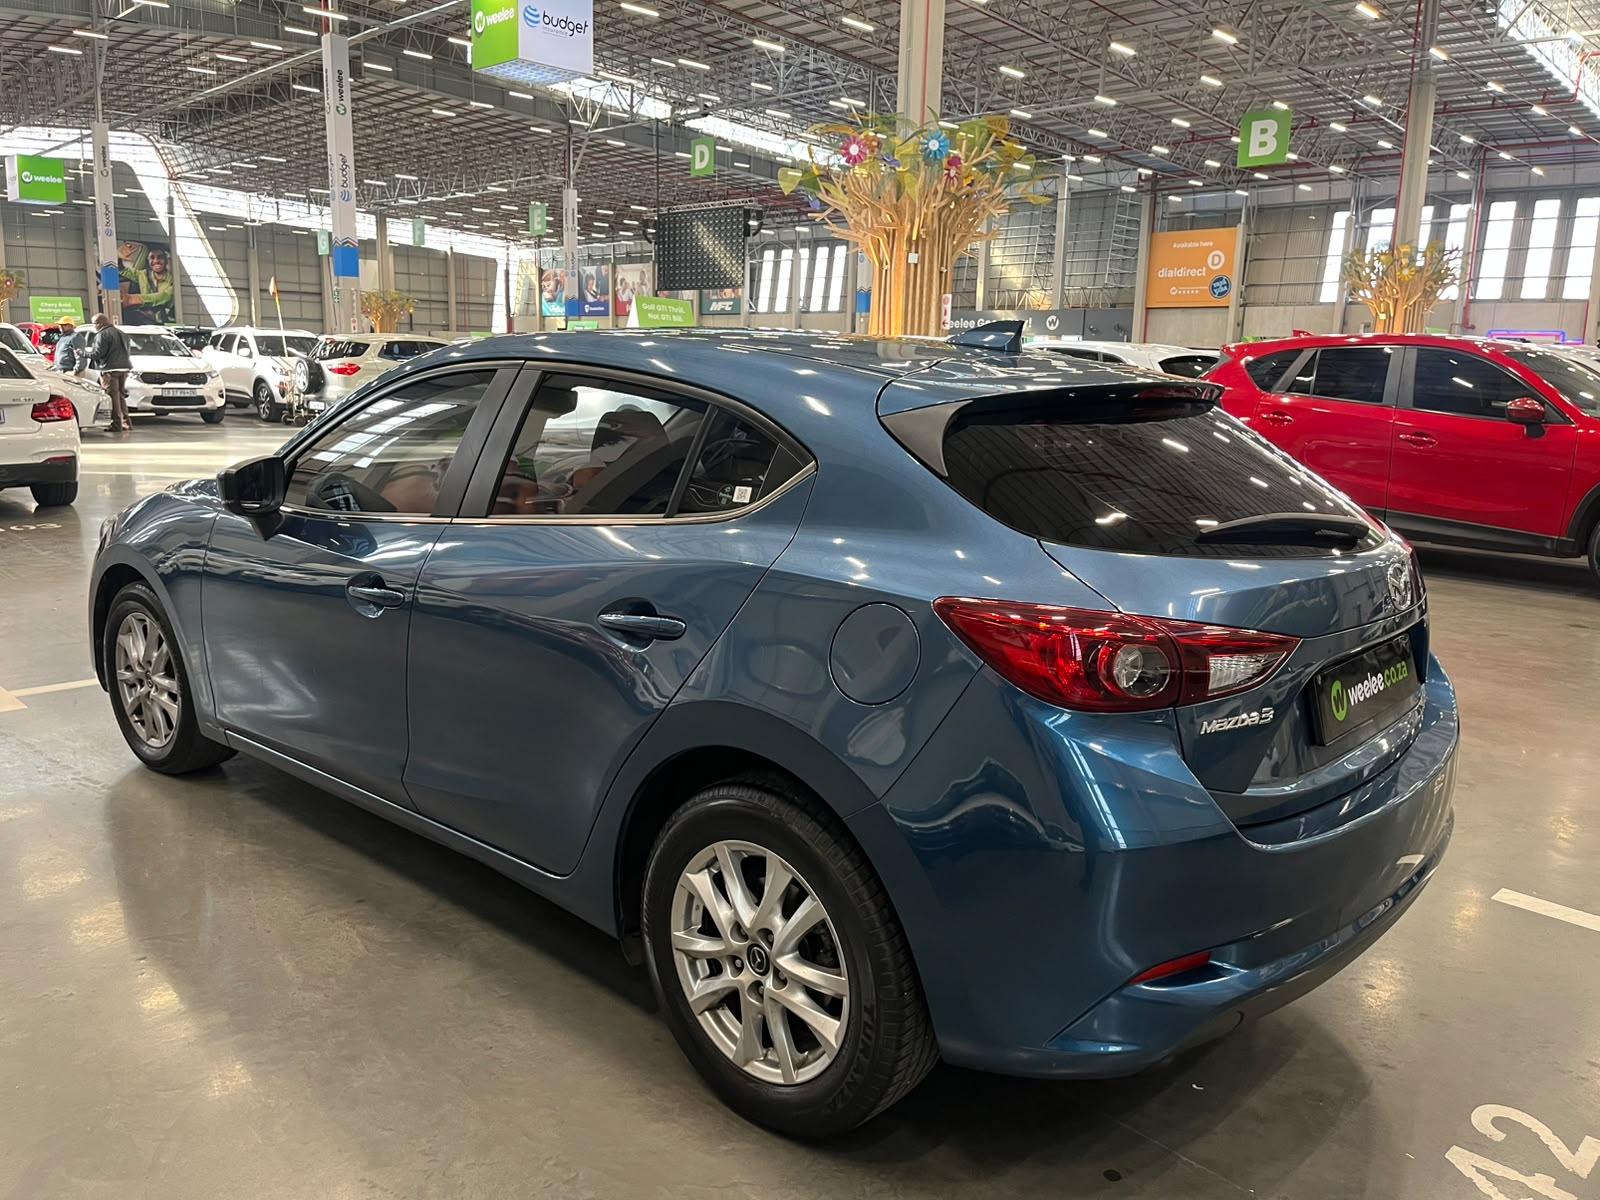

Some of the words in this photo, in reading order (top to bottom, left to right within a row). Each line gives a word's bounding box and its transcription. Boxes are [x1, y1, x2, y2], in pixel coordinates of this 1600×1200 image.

[486, 7, 515, 26] weelee
[542, 10, 588, 36] budget
[336, 69, 344, 102] weelee
[1248, 119, 1278, 158] B
[695, 144, 710, 170] D
[33, 175, 62, 184] weelee
[339, 153, 351, 188] budget
[103, 203, 112, 228] budget
[533, 208, 542, 231] E
[1158, 266, 1207, 278] dialdirect
[642, 303, 656, 311] Golf
[656, 304, 667, 312] GTI
[647, 312, 660, 320] Not
[660, 313, 671, 321] GTI
[709, 301, 734, 312] MFC
[949, 318, 975, 329] eelee
[1347, 660, 1408, 707] weelee.co.za
